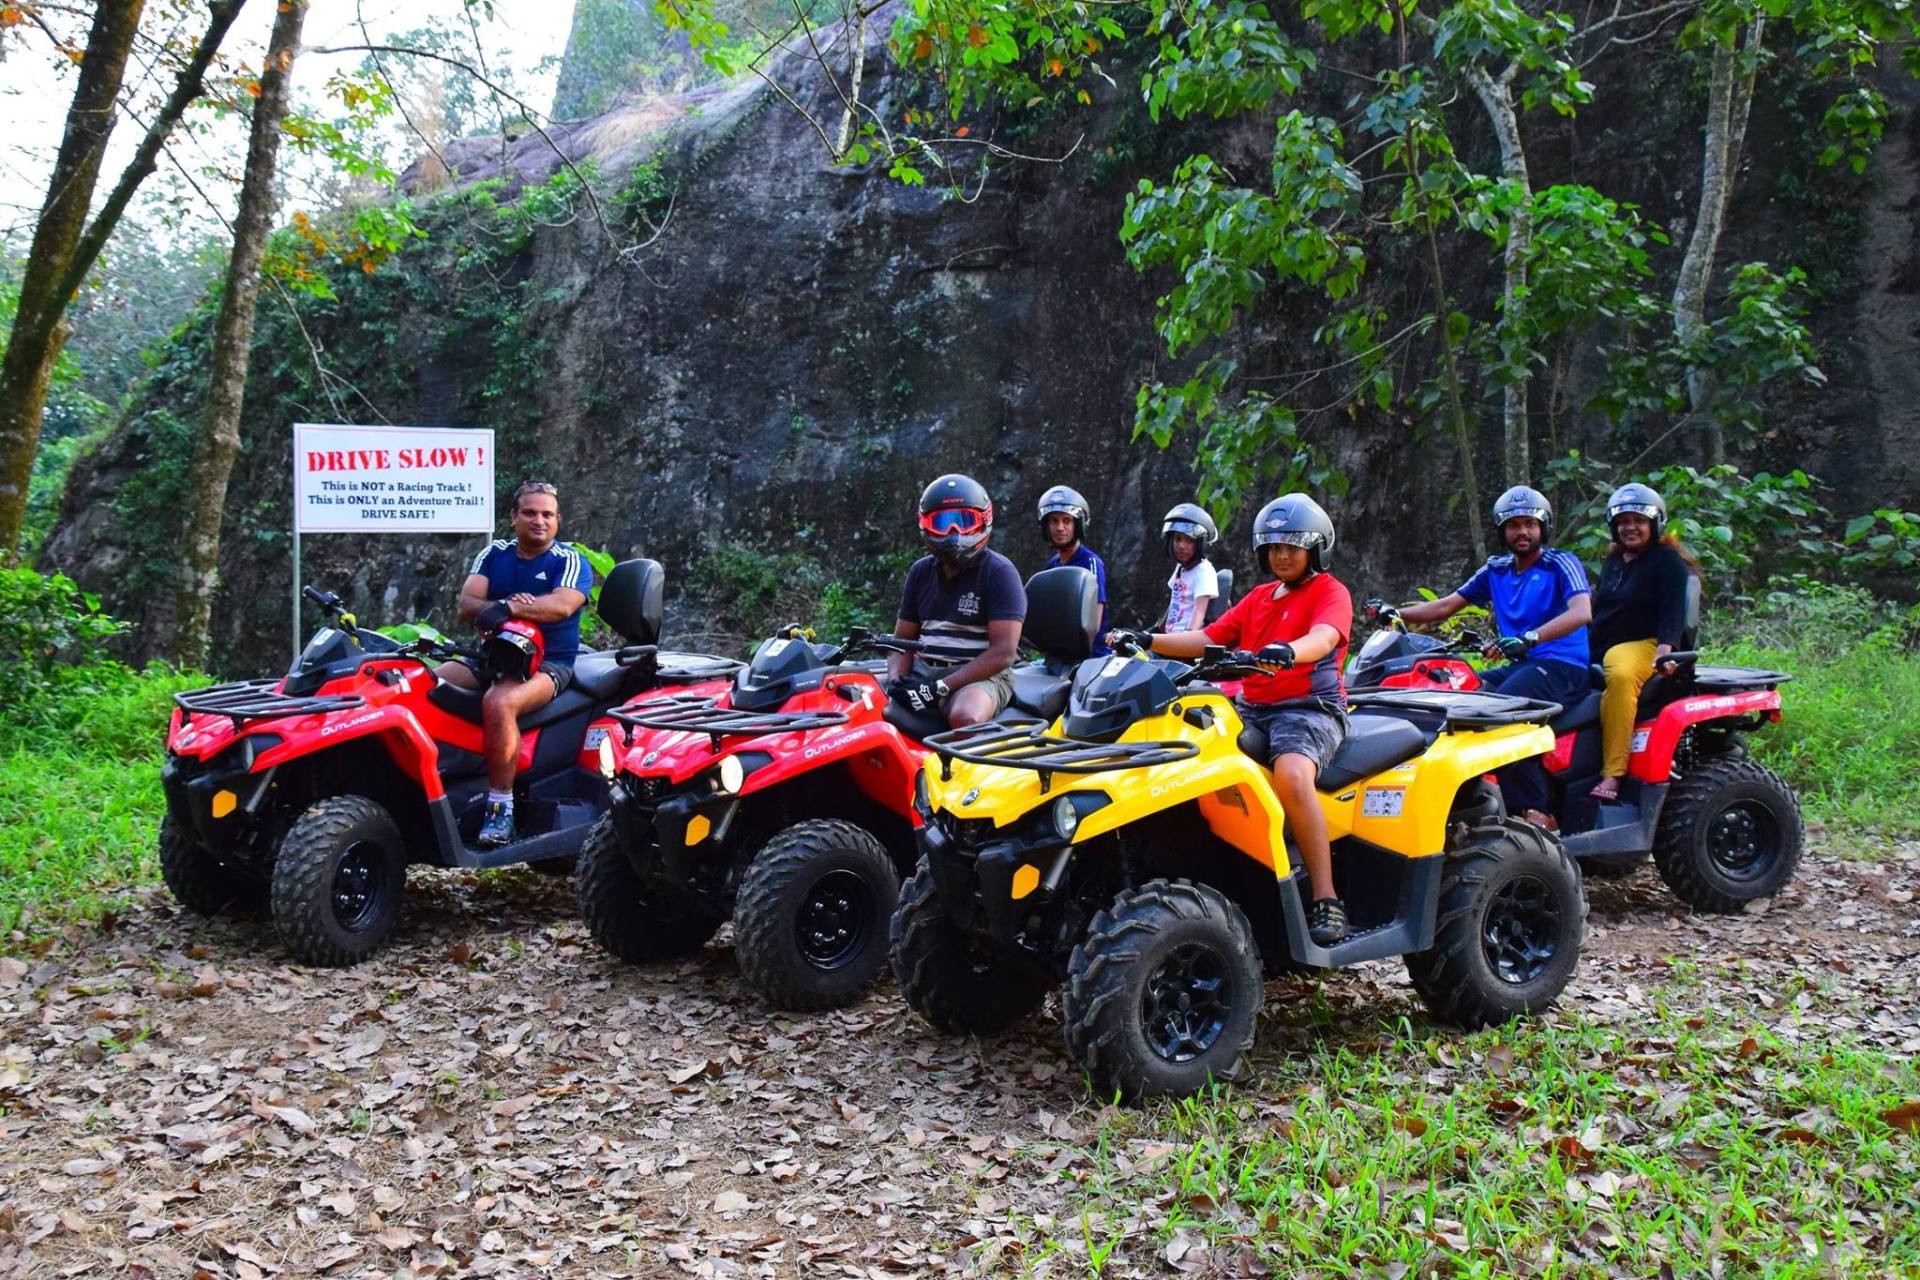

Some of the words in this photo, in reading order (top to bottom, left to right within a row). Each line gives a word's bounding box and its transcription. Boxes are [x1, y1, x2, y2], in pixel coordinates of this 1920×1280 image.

[307, 449, 391, 472] DRIVE
[398, 447, 468, 469] SLOW
[476, 447, 485, 466] !
[321, 481, 346, 491] This
[349, 481, 358, 491] is
[361, 482, 386, 491] NOT
[397, 482, 434, 494] Racing
[436, 482, 466, 492] Track
[308, 495, 333, 505] This
[335, 495, 345, 505] is
[347, 495, 379, 505] ONLY
[398, 496, 452, 506] Adventure
[454, 496, 478, 506] Trail
[361, 509, 397, 519] DRIVE
[399, 509, 429, 519] SAFE
[321, 710, 385, 737] OUTLANDER
[804, 729, 867, 759] OUTLANDER
